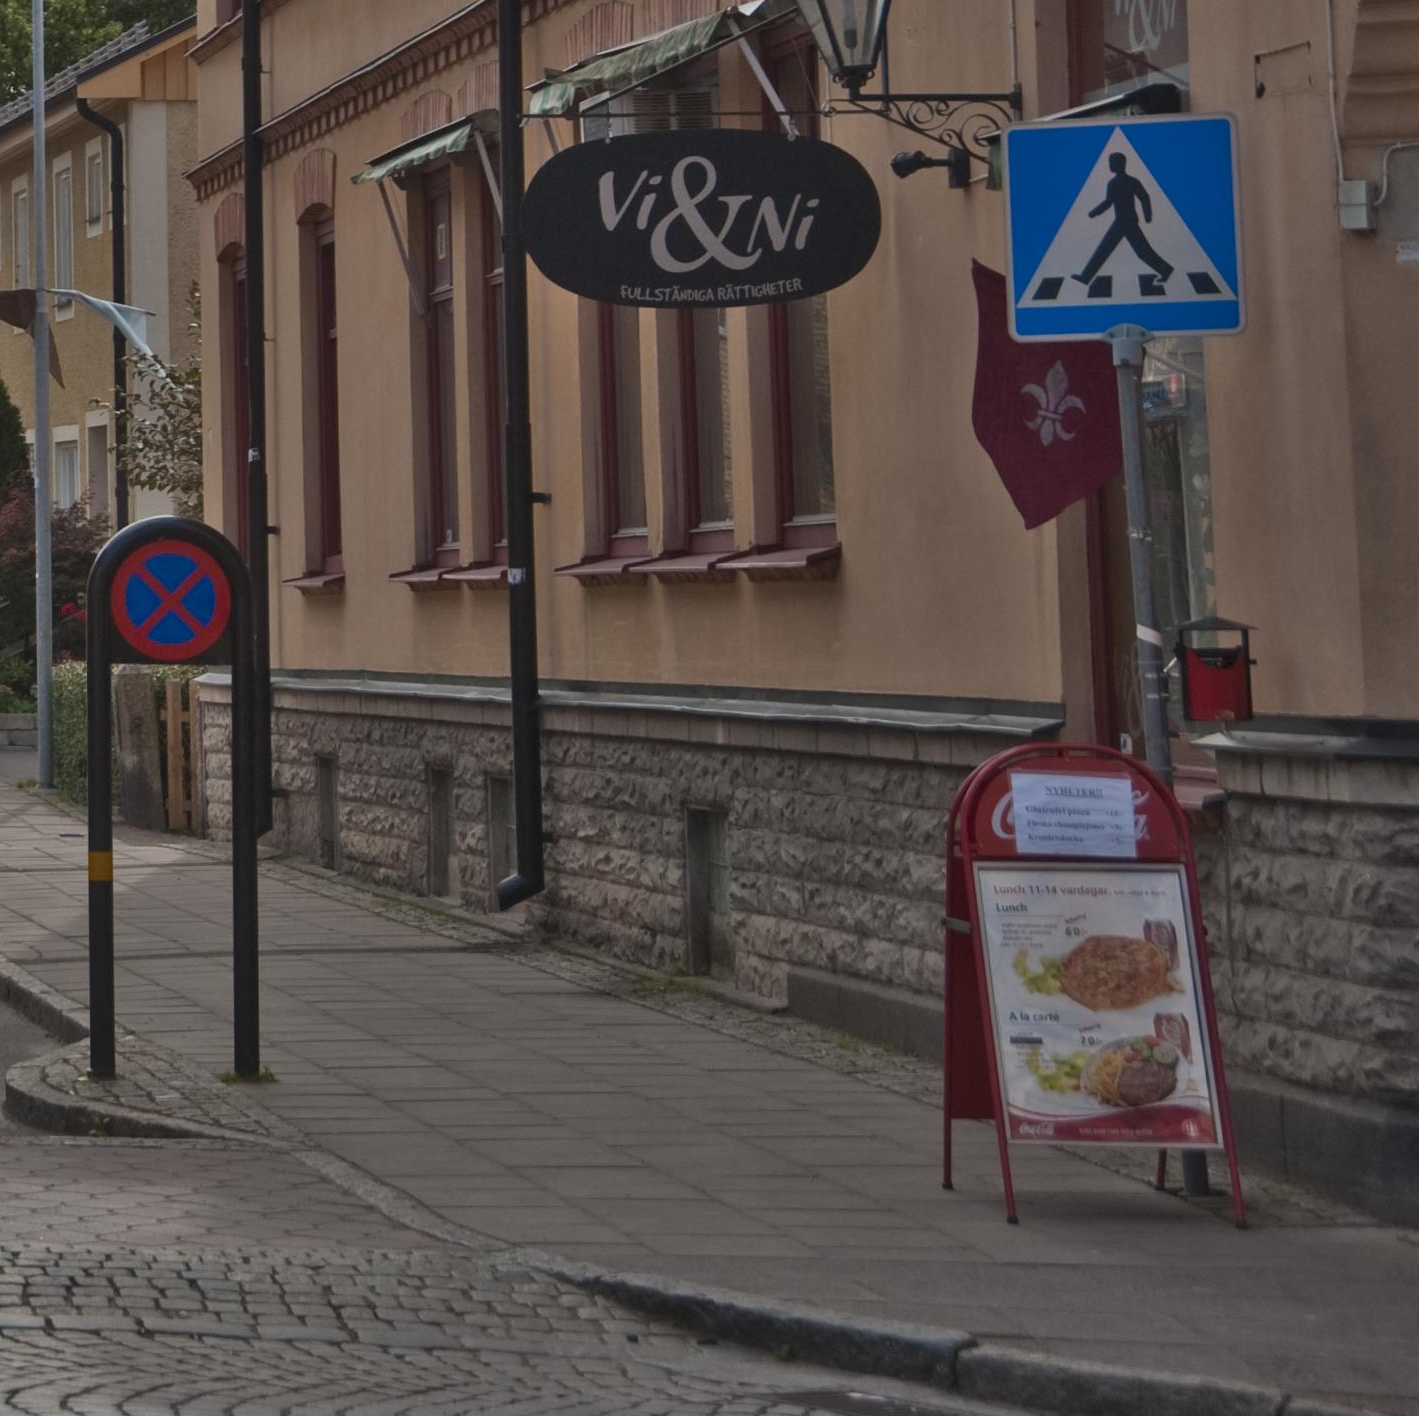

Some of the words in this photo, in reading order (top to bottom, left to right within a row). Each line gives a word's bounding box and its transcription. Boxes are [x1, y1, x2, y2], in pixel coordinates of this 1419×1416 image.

[620, 285, 714, 302] FULLSTÄNDIGA
[717, 278, 804, 300] RÄTTIGHETER
[993, 885, 1025, 895] Lunch
[996, 902, 1028, 912] Lunch
